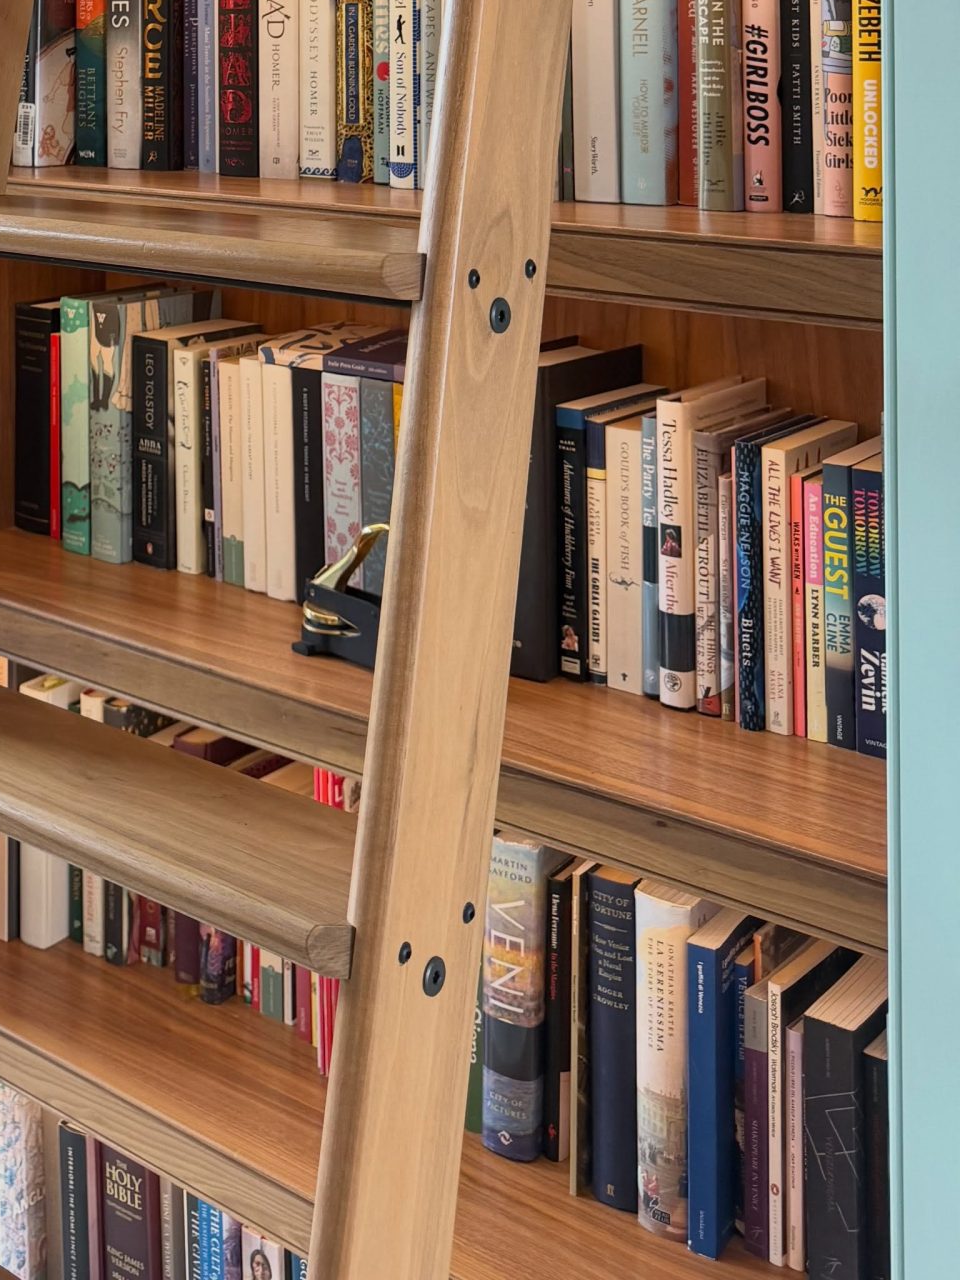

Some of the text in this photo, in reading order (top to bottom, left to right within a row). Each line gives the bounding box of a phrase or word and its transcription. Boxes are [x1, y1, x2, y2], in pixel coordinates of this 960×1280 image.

[347, 6, 358, 18] IN
[347, 25, 358, 58] GARDEN
[711, 16, 724, 48] THE
[791, 18, 800, 49] KIDS
[78, 67, 88, 128] HUGHES
[86, 66, 97, 129] BETTANY
[111, 46, 129, 135] Stephen Fry
[271, 43, 283, 92] HOMER
[308, 70, 321, 116] HOMER
[347, 60, 358, 95] BURNING
[394, 51, 409, 138] Son of Nobody
[744, 22, 771, 148] #GIRLBOSS
[143, 84, 155, 141] MILLER
[154, 85, 165, 142] MADELINE
[347, 96, 358, 120] GOLD
[377, 88, 385, 135] HOFFMAN
[791, 63, 801, 147] PATTI SMITH
[862, 79, 877, 169] UNLOCKED
[144, 353, 157, 431] LEO TOLSTOY
[640, 437, 656, 499] The Party
[659, 419, 678, 523] Tessa Hadley
[823, 492, 846, 507] THE
[619, 441, 631, 571] GOULD'S BOOK of FISH
[696, 447, 712, 598] ELIZABETH STROUT
[738, 470, 753, 589] MAGGIE NELSON
[767, 460, 782, 590] ALL THE LIVES I WANT
[808, 493, 822, 580] An Education
[854, 488, 868, 577] TOMORROW
[867, 490, 881, 579] TOMORROW
[823, 505, 850, 601] GUEST
[591, 558, 602, 645] THE GREAT GATSBY
[810, 587, 823, 669] LYNN BARBER
[826, 612, 839, 653] CLINE
[741, 617, 755, 668] Bluets
[839, 614, 852, 655] EMMA
[776, 670, 785, 701] ALANA
[858, 648, 880, 712] Zevin
[835, 714, 844, 741] VINTAGE
[655, 939, 667, 1054] LA SERENISSIMA
[666, 943, 677, 1039] JONATHAN KEATES
[768, 990, 780, 1056] Joseph Brodsky
[105, 1161, 143, 1193] HOLY
[106, 1179, 143, 1211] BIBLE
[208, 1209, 222, 1272] THE CULT
